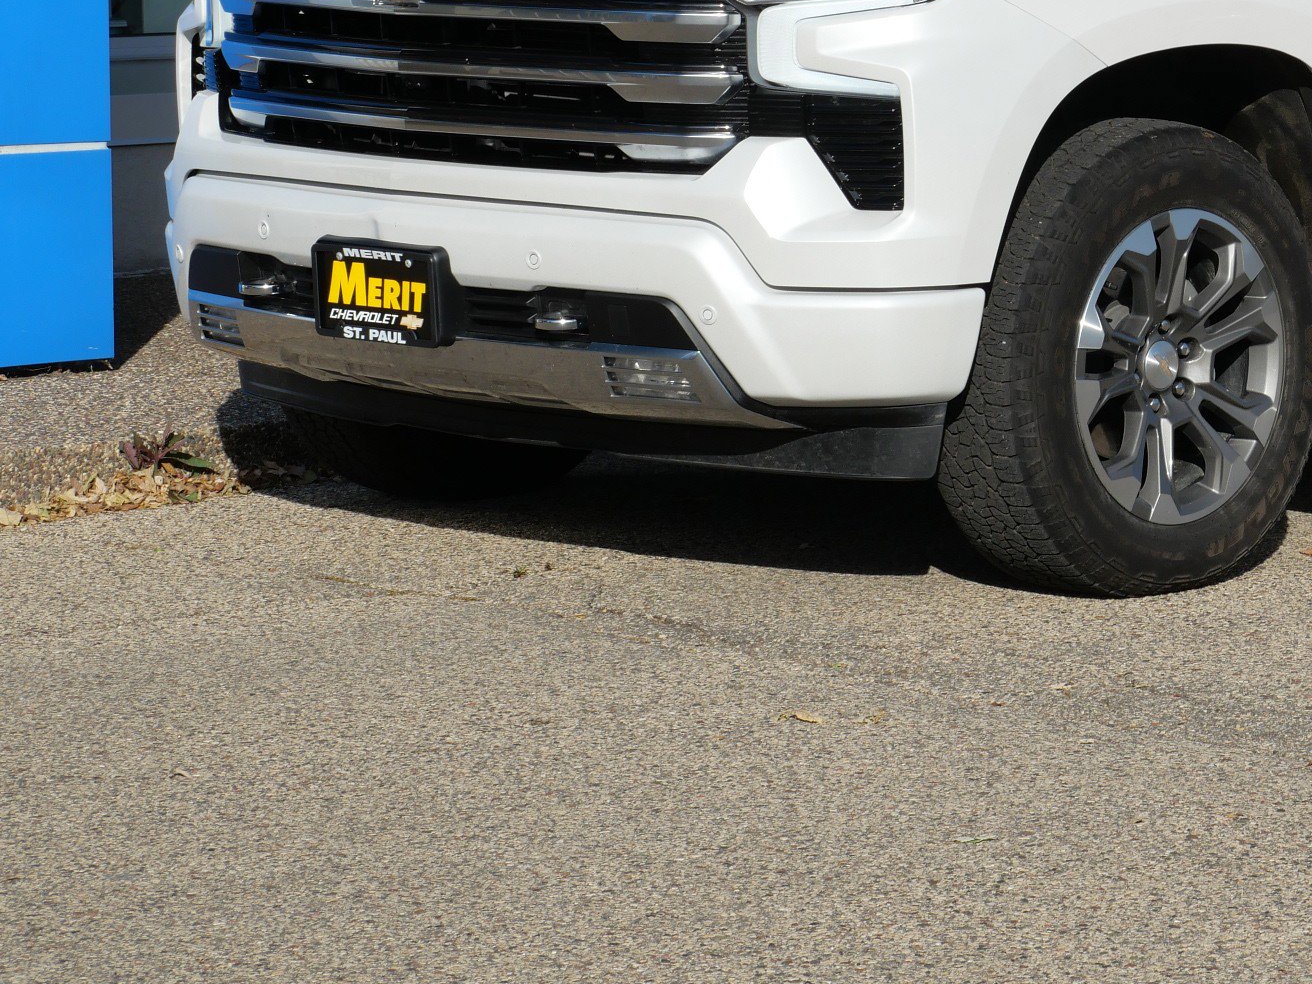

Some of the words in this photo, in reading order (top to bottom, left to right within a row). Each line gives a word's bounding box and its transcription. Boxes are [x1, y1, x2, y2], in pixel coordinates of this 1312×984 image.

[342, 247, 403, 262] MERIT
[327, 260, 426, 313] MERIT
[329, 307, 399, 325] CHEVROLET
[342, 325, 365, 340] ST.
[368, 328, 407, 345] PAUL
